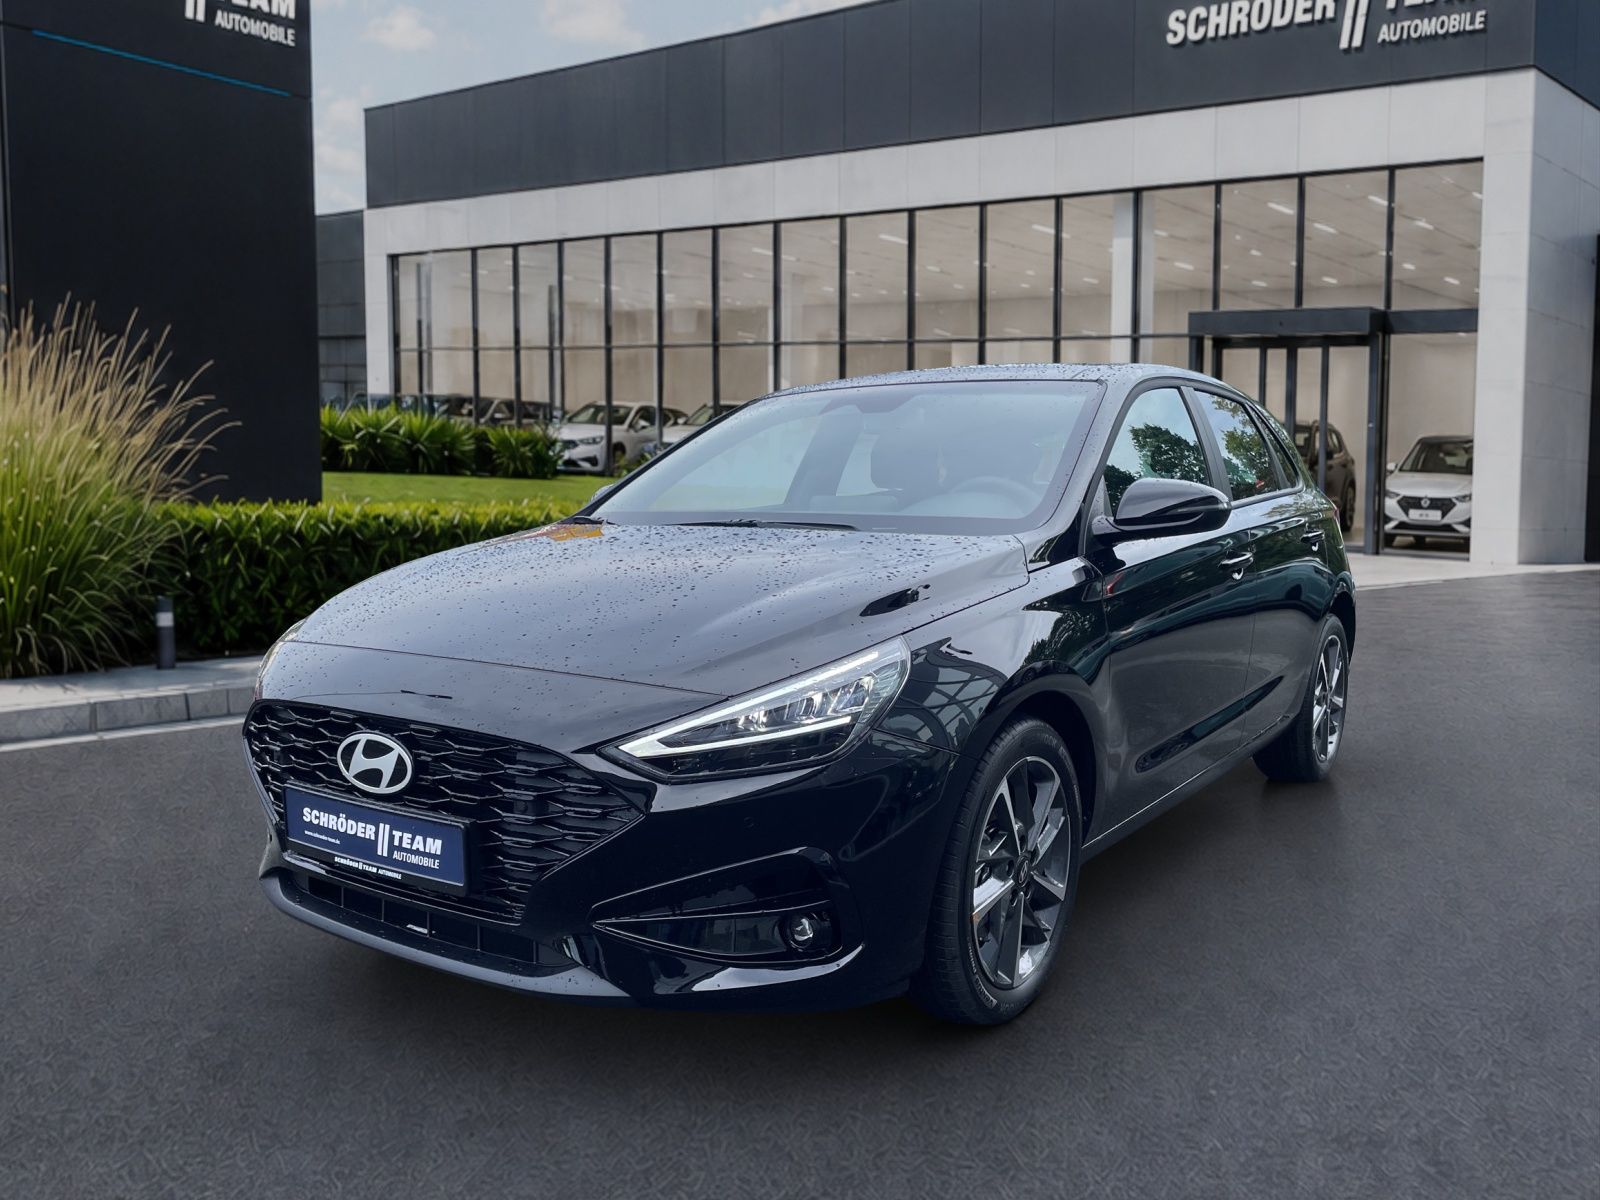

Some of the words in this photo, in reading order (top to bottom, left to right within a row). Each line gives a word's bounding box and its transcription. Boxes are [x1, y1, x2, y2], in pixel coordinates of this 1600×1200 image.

[214, 9, 296, 47] AUTOMOBILE
[1377, 9, 1487, 43] AUTOMOBILE
[302, 807, 376, 841] SCHRÖDER
[393, 830, 443, 856] TEAM
[393, 850, 440, 870] AUTOMOBILE
